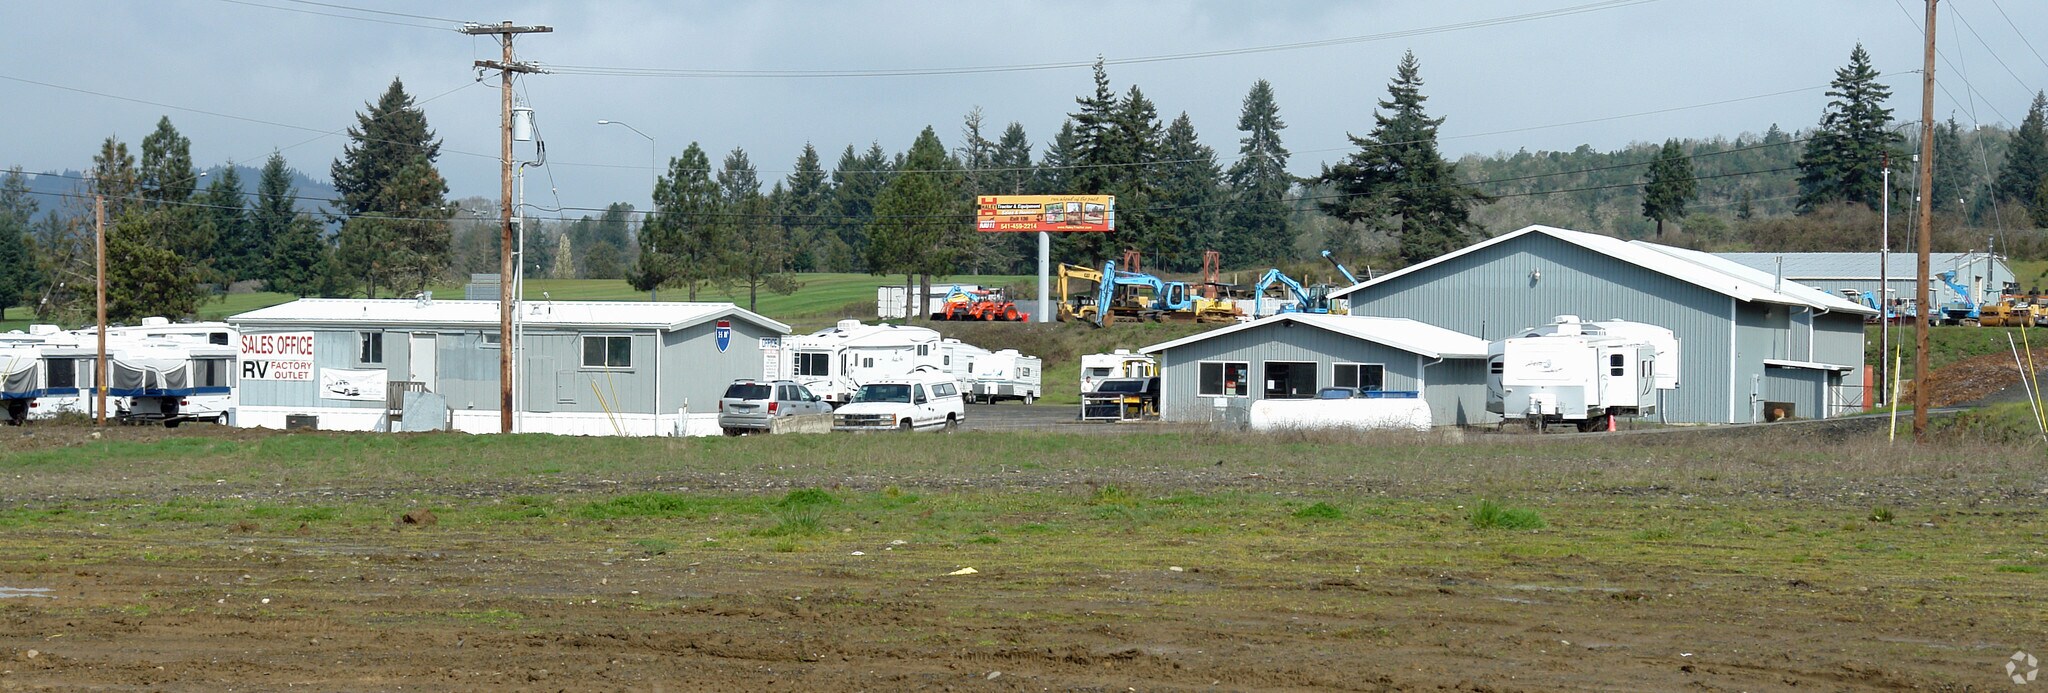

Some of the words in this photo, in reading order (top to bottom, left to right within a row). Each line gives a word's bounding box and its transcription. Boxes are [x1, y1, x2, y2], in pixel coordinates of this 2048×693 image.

[241, 334, 274, 354] SALES
[277, 335, 313, 355] OFFICE
[761, 338, 778, 348] OFFICE
[242, 360, 269, 379] RV
[270, 361, 312, 370] FACTORY
[274, 371, 309, 379] OUTLET
